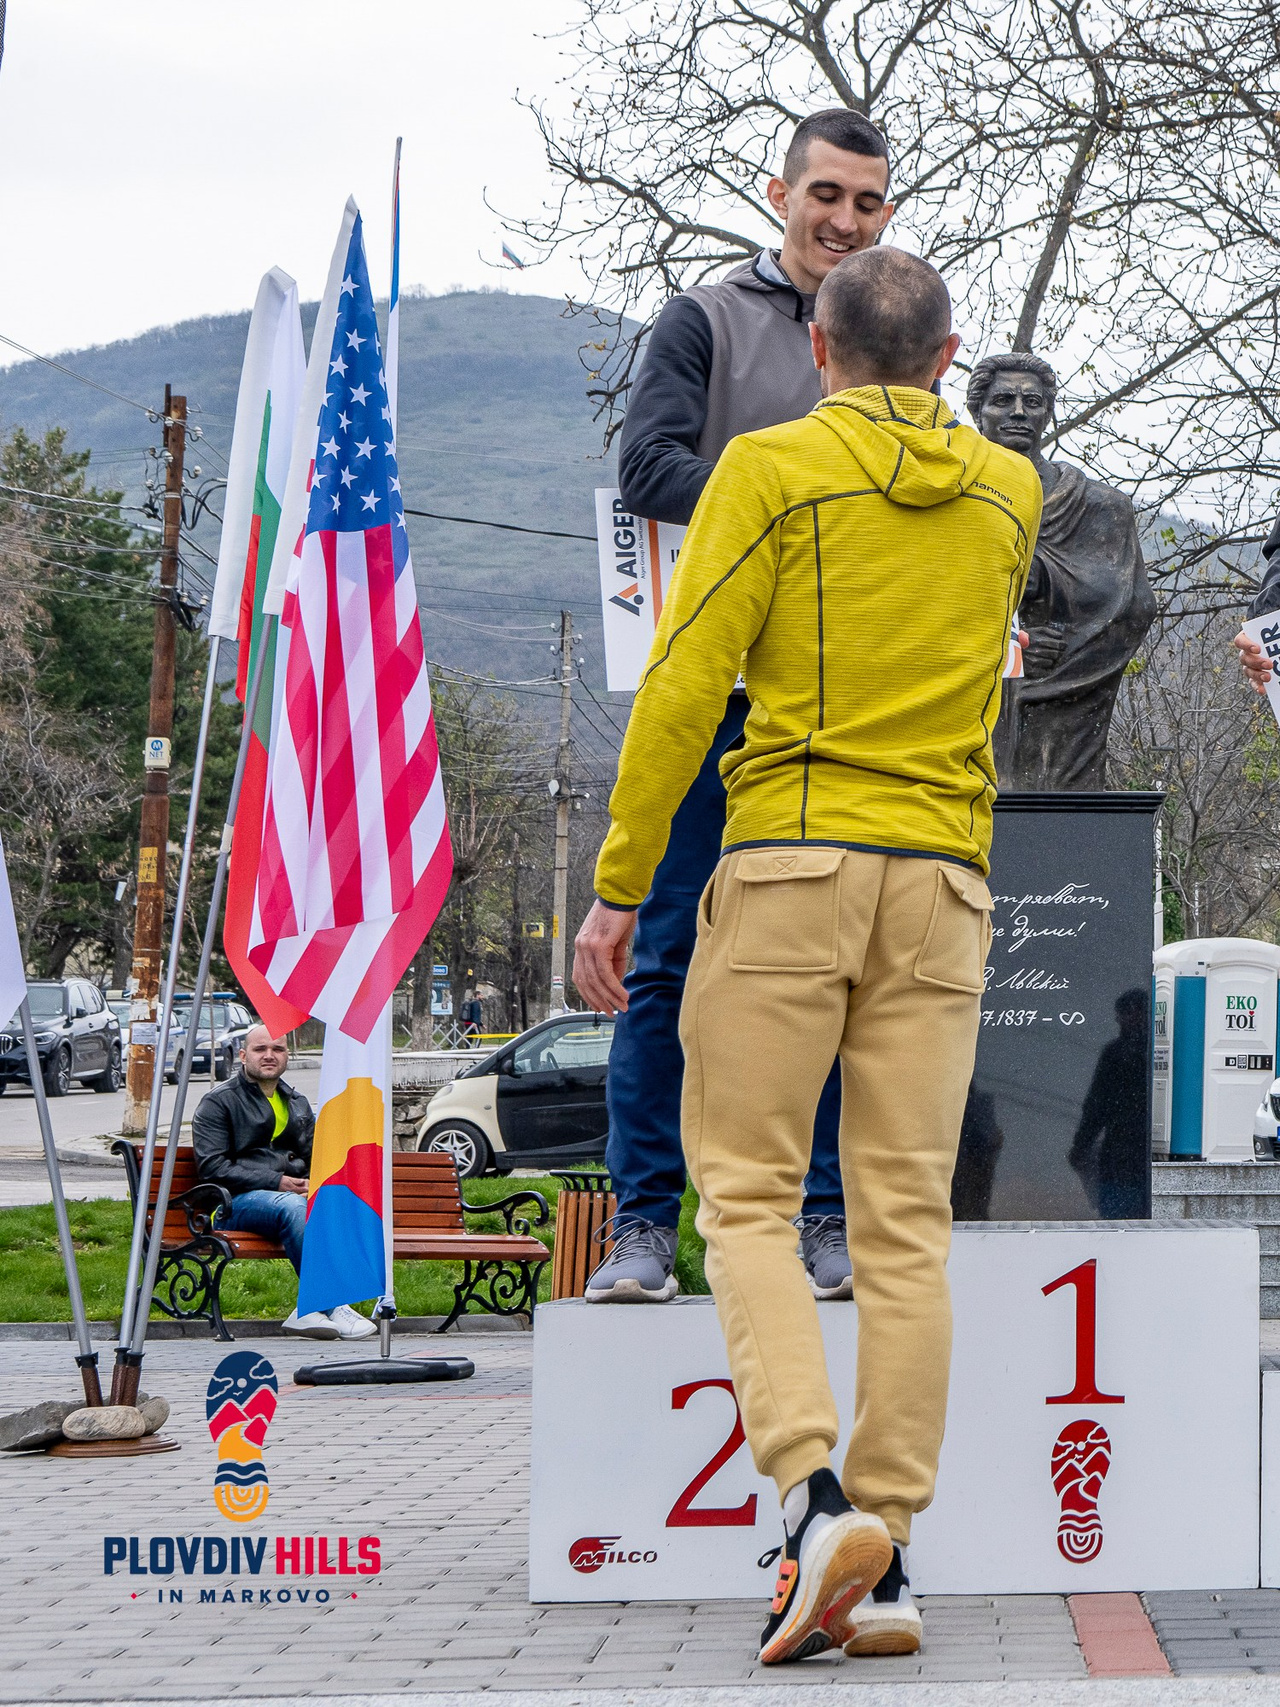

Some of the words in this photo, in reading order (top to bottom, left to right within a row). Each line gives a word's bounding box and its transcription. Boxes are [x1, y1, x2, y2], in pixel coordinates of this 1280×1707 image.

[1226, 996, 1257, 1010] EKO
[1041, 1258, 1126, 1405] 1
[665, 1378, 758, 1528] 2
